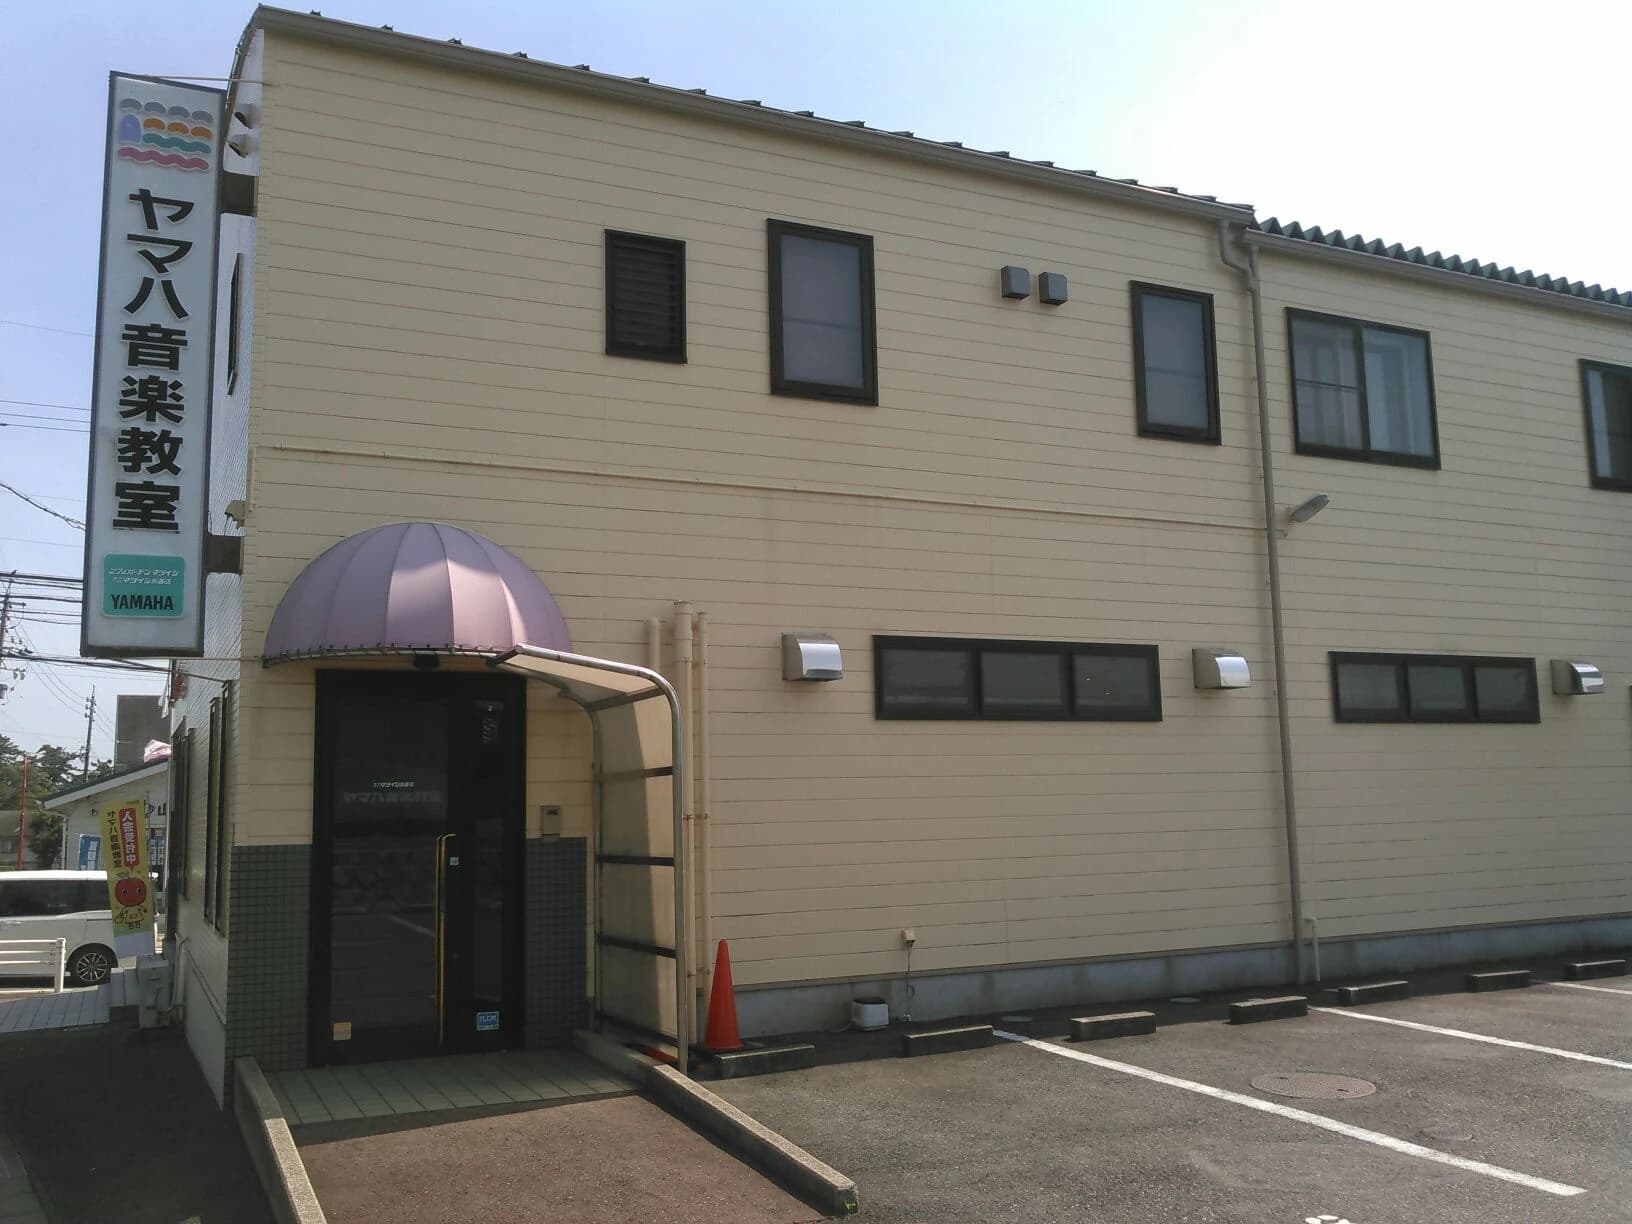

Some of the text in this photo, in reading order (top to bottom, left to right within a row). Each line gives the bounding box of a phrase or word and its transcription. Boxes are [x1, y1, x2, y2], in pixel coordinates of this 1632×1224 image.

[112, 188, 195, 531] ヤマハ音楽教室
[111, 594, 174, 611] YAMAHA
